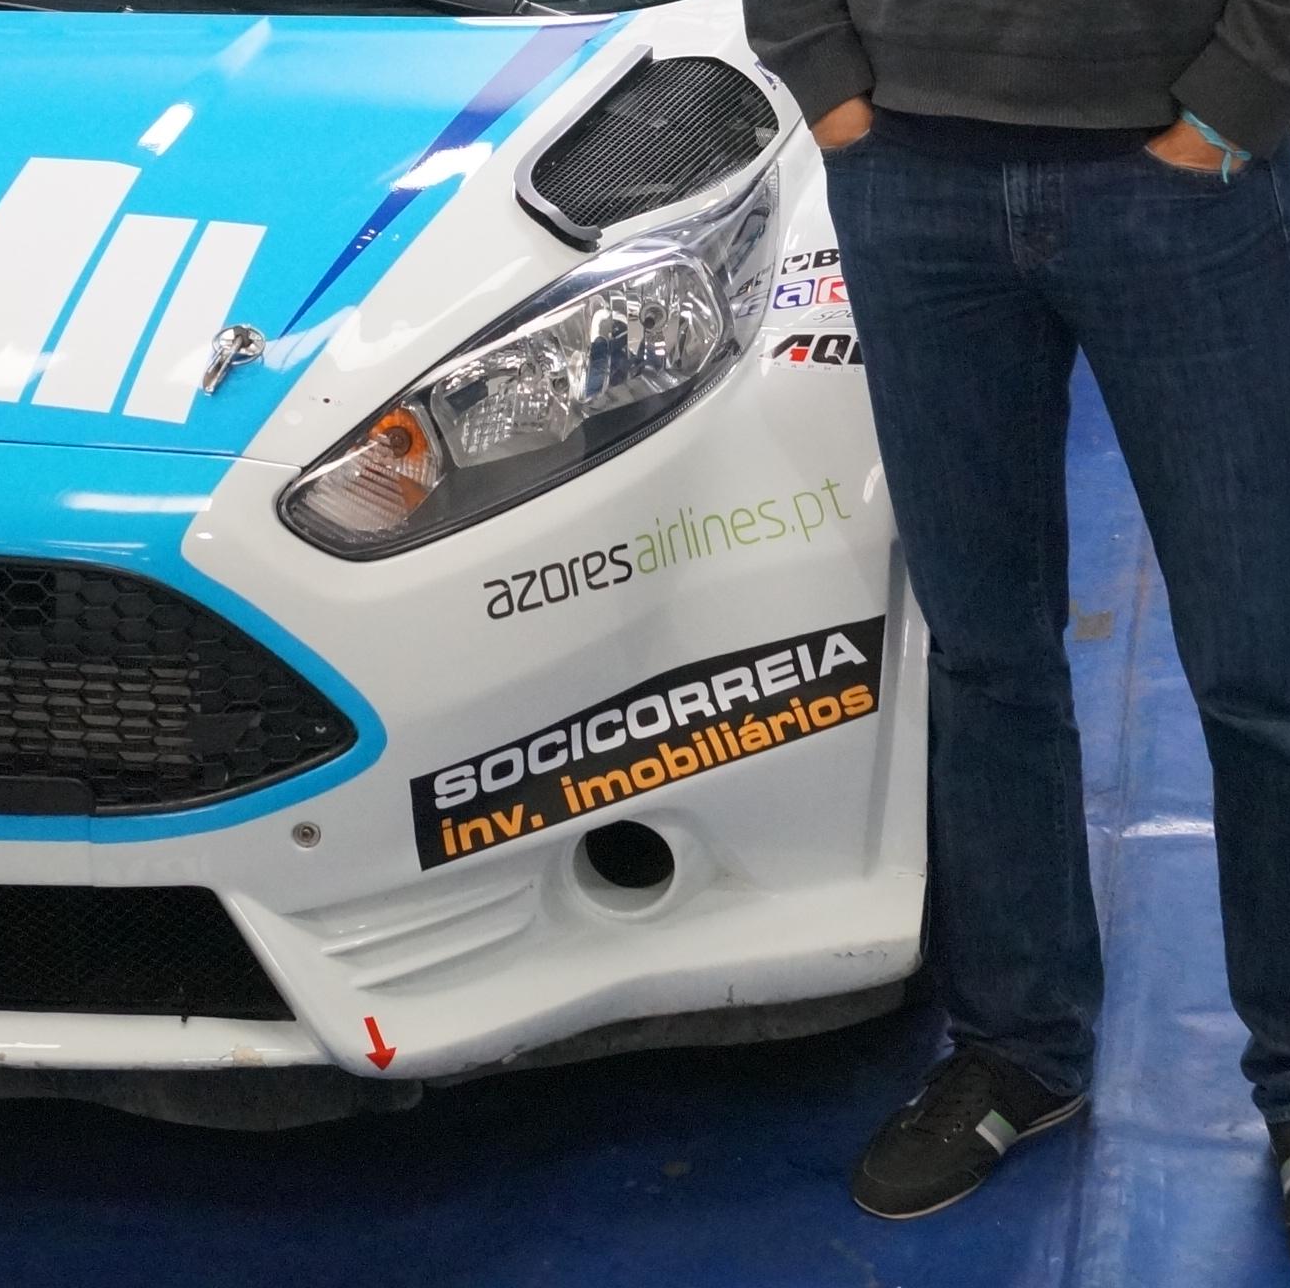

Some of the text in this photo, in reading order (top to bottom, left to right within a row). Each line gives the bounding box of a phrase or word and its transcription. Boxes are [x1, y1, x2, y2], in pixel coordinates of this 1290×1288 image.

[434, 631, 869, 810] SOCICORREIA
[441, 683, 875, 857] inv. imobiliários
